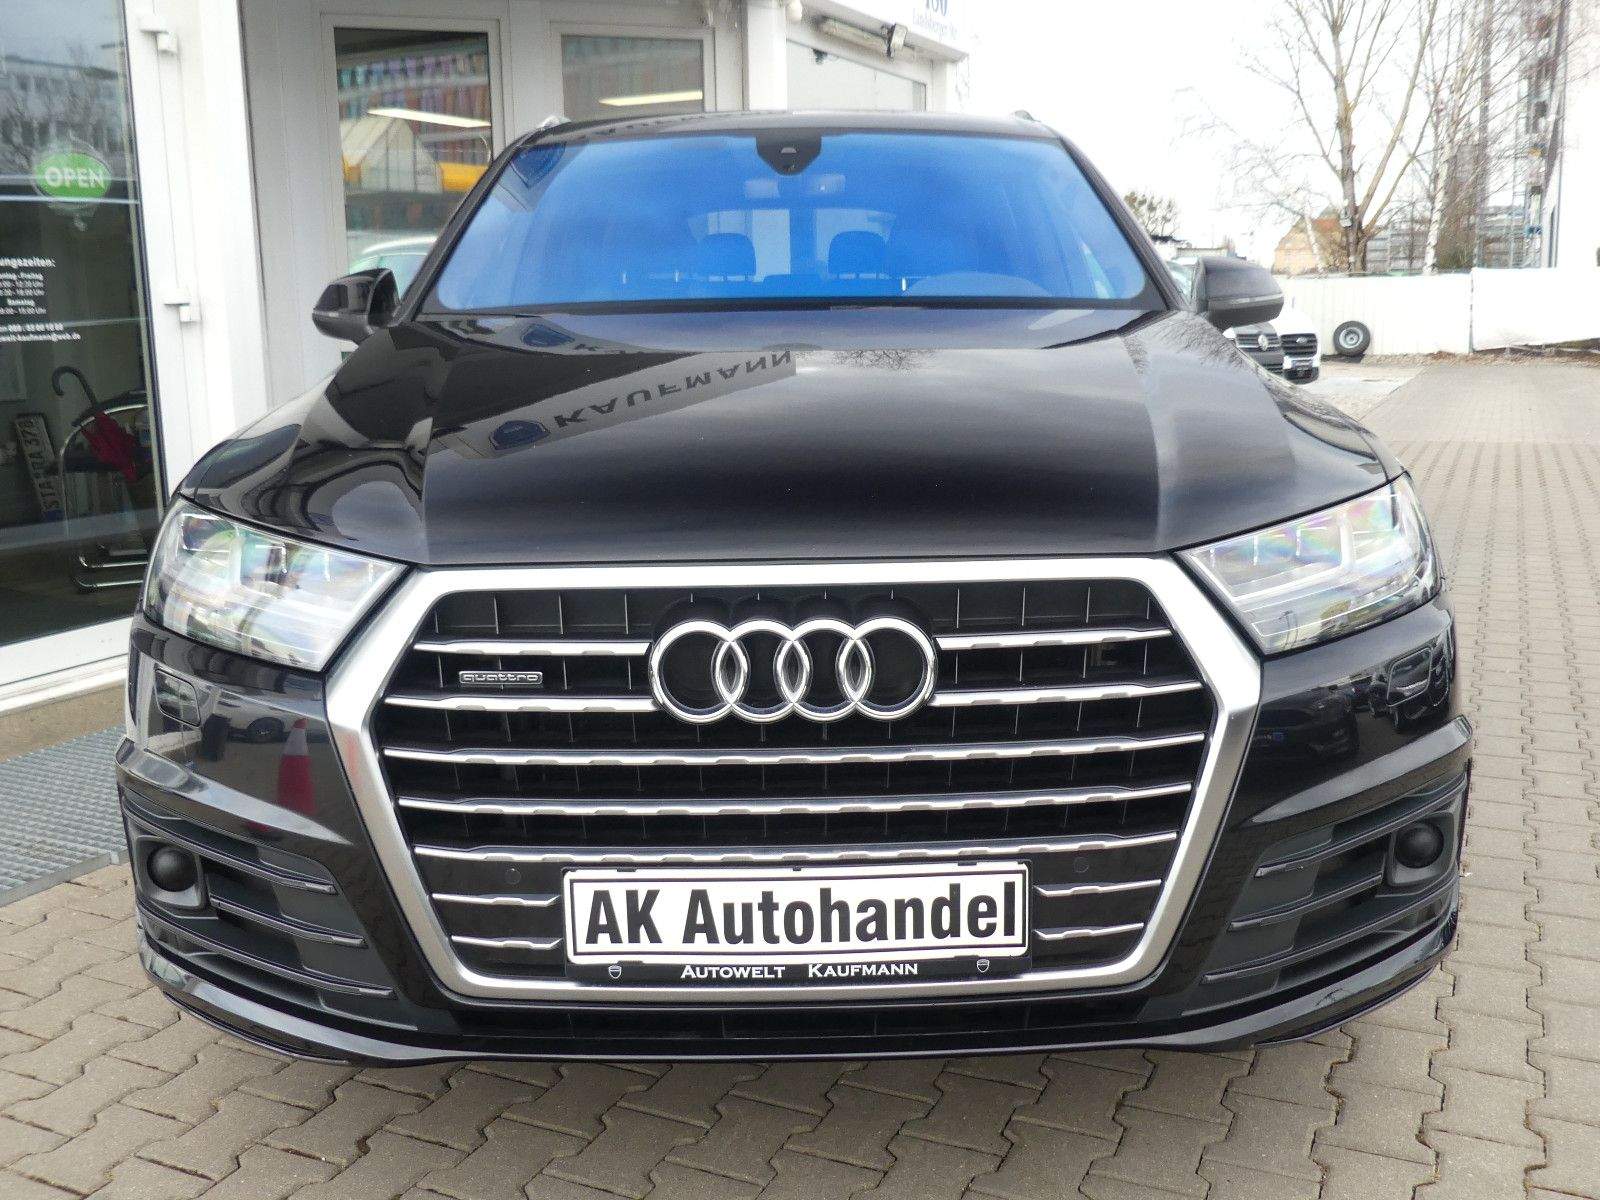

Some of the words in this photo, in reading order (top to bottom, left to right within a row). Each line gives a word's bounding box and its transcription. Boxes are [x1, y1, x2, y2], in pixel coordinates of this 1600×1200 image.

[45, 166, 104, 189] OPEN
[463, 673, 539, 683] quattro
[585, 888, 663, 945] AK
[682, 880, 1016, 945] Autohandel
[680, 964, 786, 979] AUTOWELT
[808, 963, 919, 977] KAUFMANN
